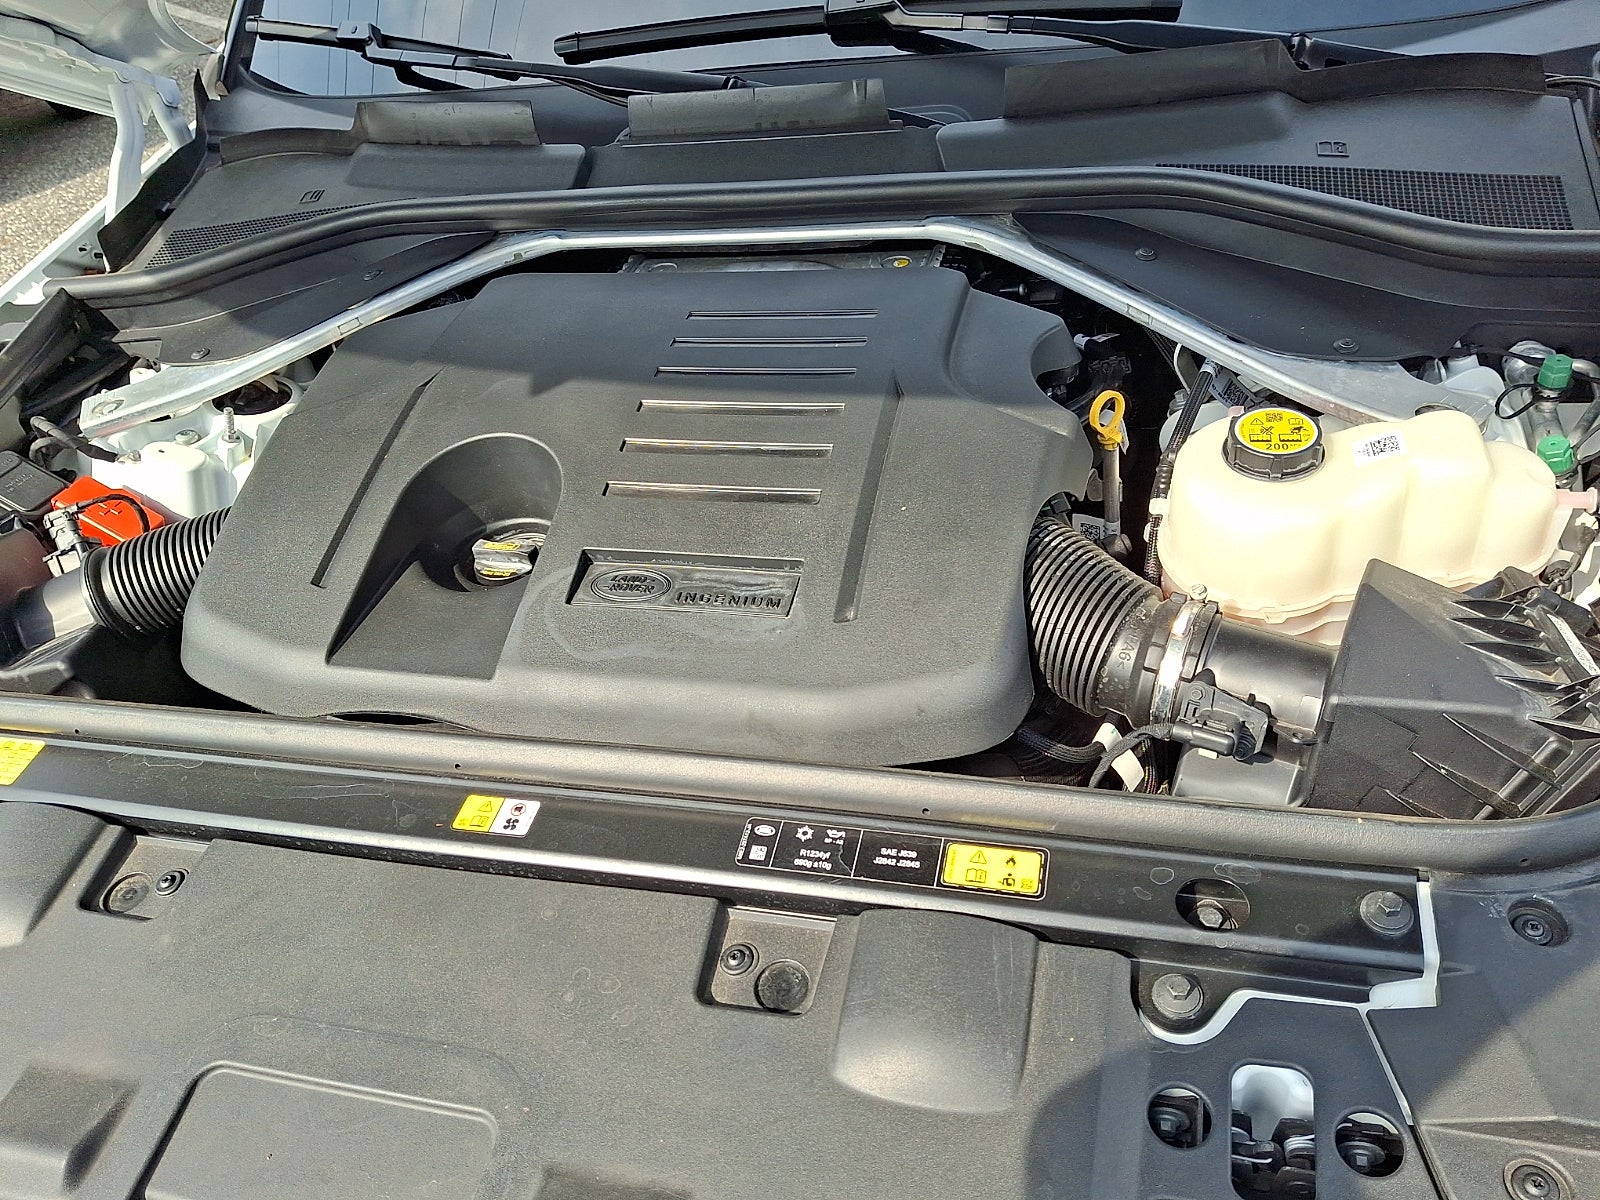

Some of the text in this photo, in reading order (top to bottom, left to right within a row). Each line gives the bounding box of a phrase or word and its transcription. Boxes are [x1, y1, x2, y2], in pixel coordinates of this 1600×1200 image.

[1266, 443, 1289, 451] 200
[674, 591, 782, 609] INGENIUM
[799, 848, 831, 860] R1234yf
[880, 847, 898, 856] SAE
